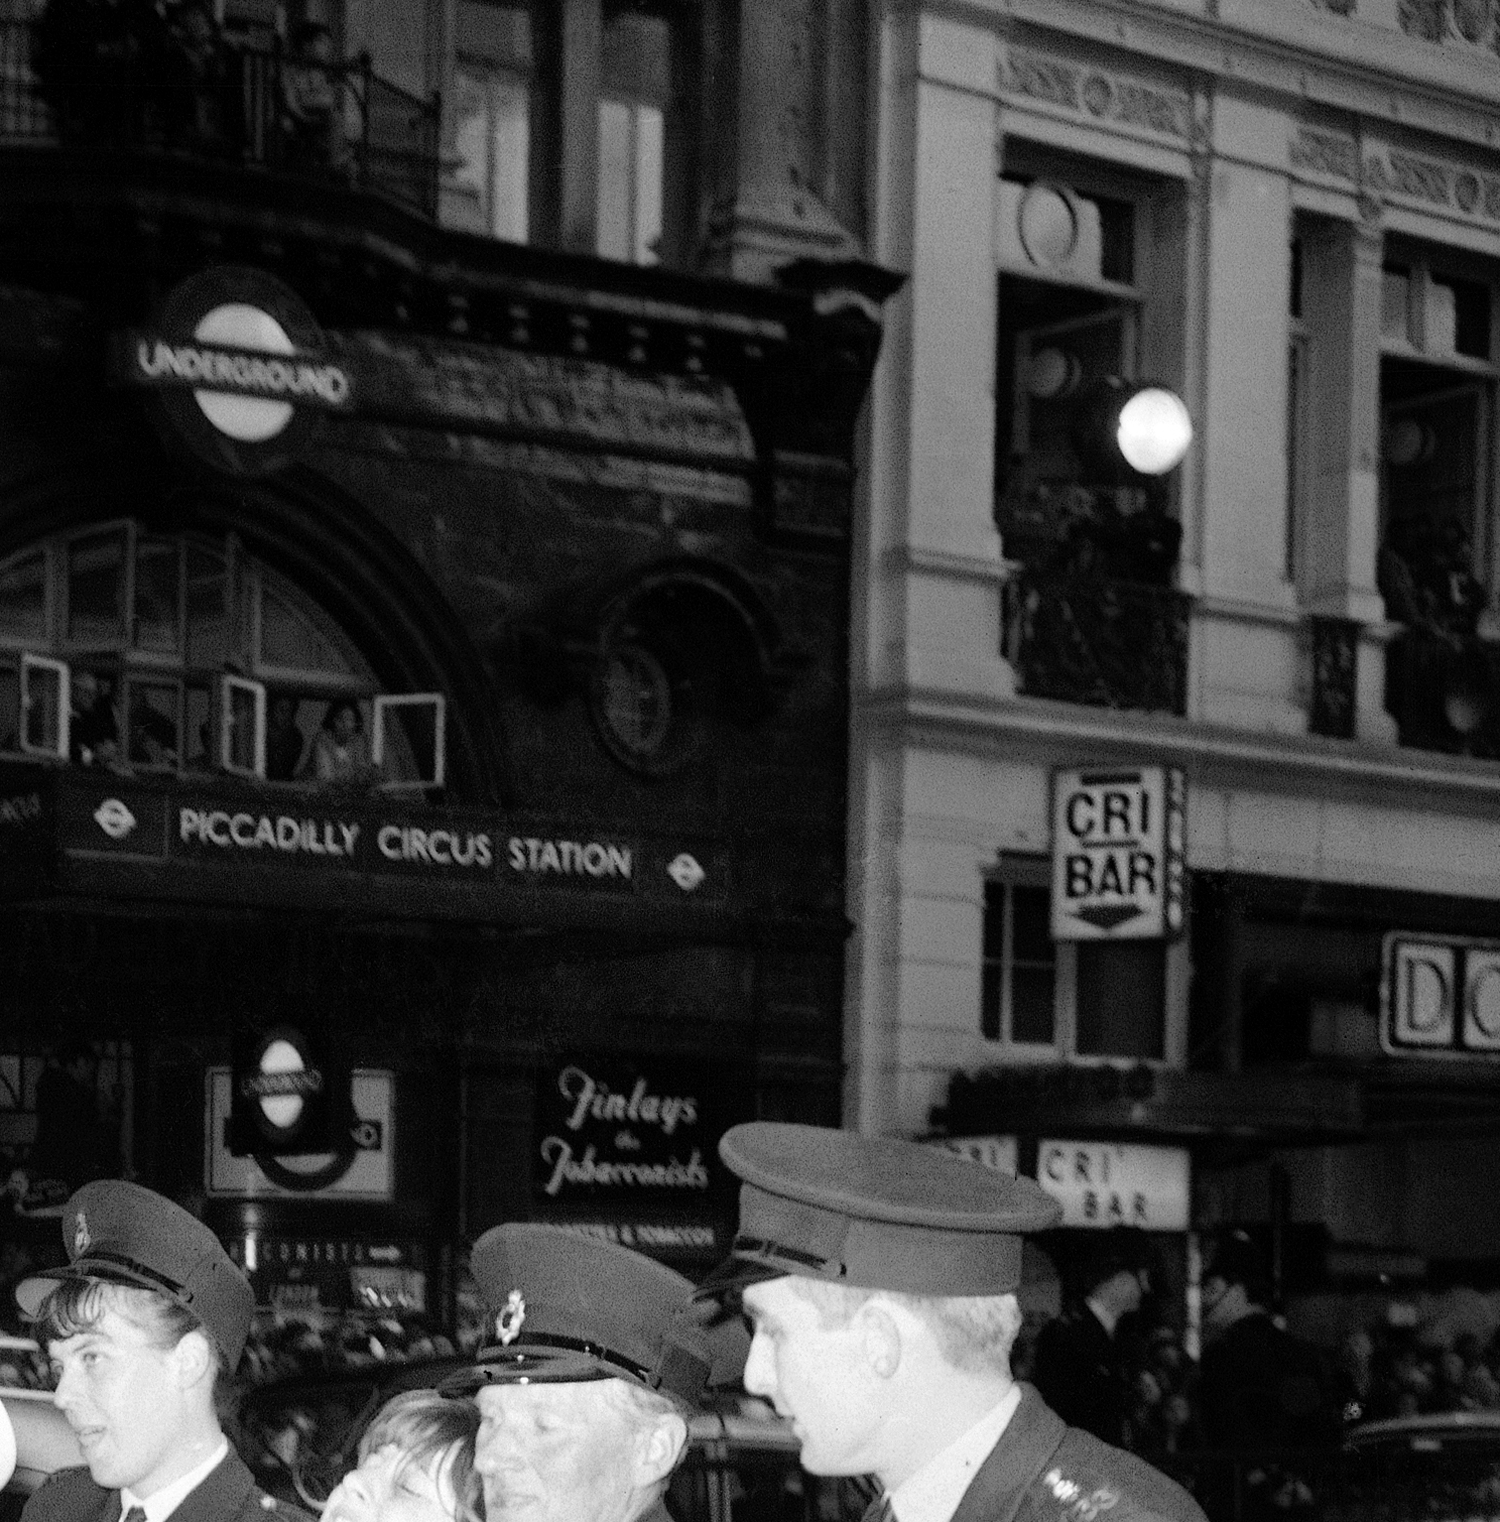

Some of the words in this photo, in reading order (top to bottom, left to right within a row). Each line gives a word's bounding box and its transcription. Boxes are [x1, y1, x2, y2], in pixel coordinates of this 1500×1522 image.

[136, 336, 351, 405] UNDERGROUND
[177, 805, 361, 859] PICCADILLY
[375, 823, 495, 869] CIRCUS
[506, 835, 634, 881] STATION
[1065, 789, 1151, 839] CRI
[1064, 852, 1158, 899] BAR
[557, 1063, 700, 1137] Finlays
[1083, 1191, 1149, 1221] BAR
